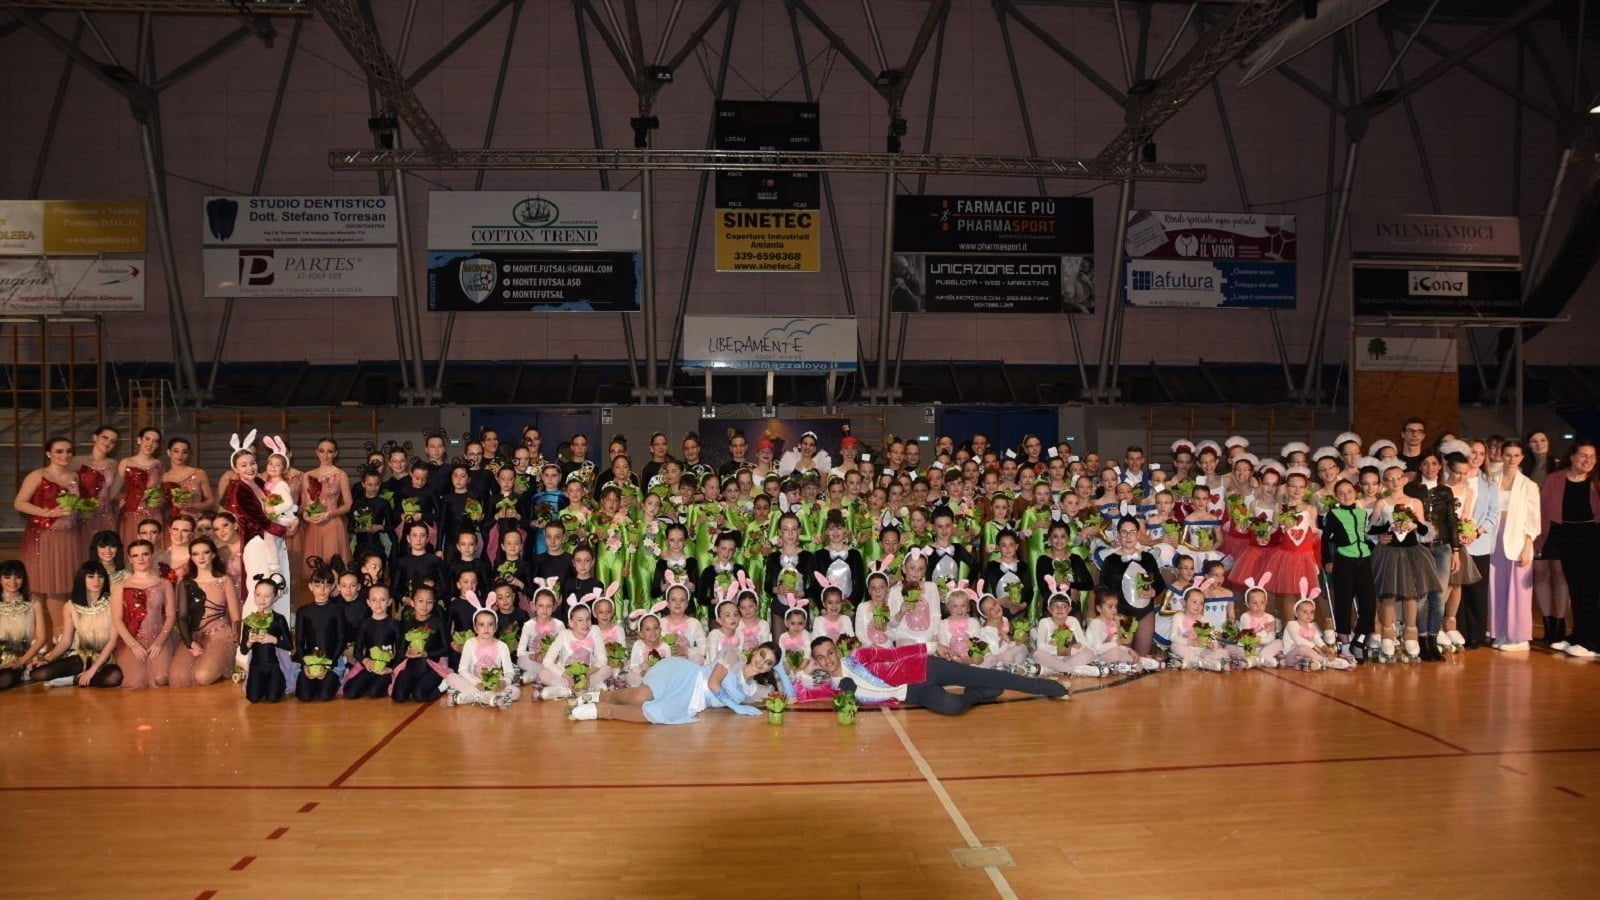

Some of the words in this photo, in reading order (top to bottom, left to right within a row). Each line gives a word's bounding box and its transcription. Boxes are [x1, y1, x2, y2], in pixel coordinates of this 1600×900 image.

[249, 199, 300, 209] STUDIO
[304, 199, 386, 209] DENTISTICO
[957, 200, 1026, 214] FARMACIE
[1031, 198, 1056, 215] PIÙ
[249, 211, 278, 222] Dott.
[281, 211, 329, 222] Stefano
[334, 211, 386, 222] Torresan
[723, 212, 812, 228] SINETEC
[957, 219, 1057, 233] PHARMASPORT
[1375, 223, 1494, 240] INTENDIAMOCI
[471, 229, 535, 242] COTTON
[540, 229, 598, 242] TREND
[750, 241, 785, 249] Amianto
[958, 241, 1028, 251] www.pharmasport.it
[1200, 244, 1210, 258] IL
[1211, 244, 1236, 258] VINO
[733, 252, 802, 260] 339-6596368
[512, 264, 614, 273] MONTE.FUTSAL@GMAIL.COM
[512, 278, 537, 286] MONTE
[539, 278, 565, 286] FUTSAL
[567, 278, 581, 286] ASD
[1413, 276, 1463, 291] iCona
[512, 290, 564, 299] MONTEFUTSAL
[708, 335, 805, 353] LIBERAMENTE
